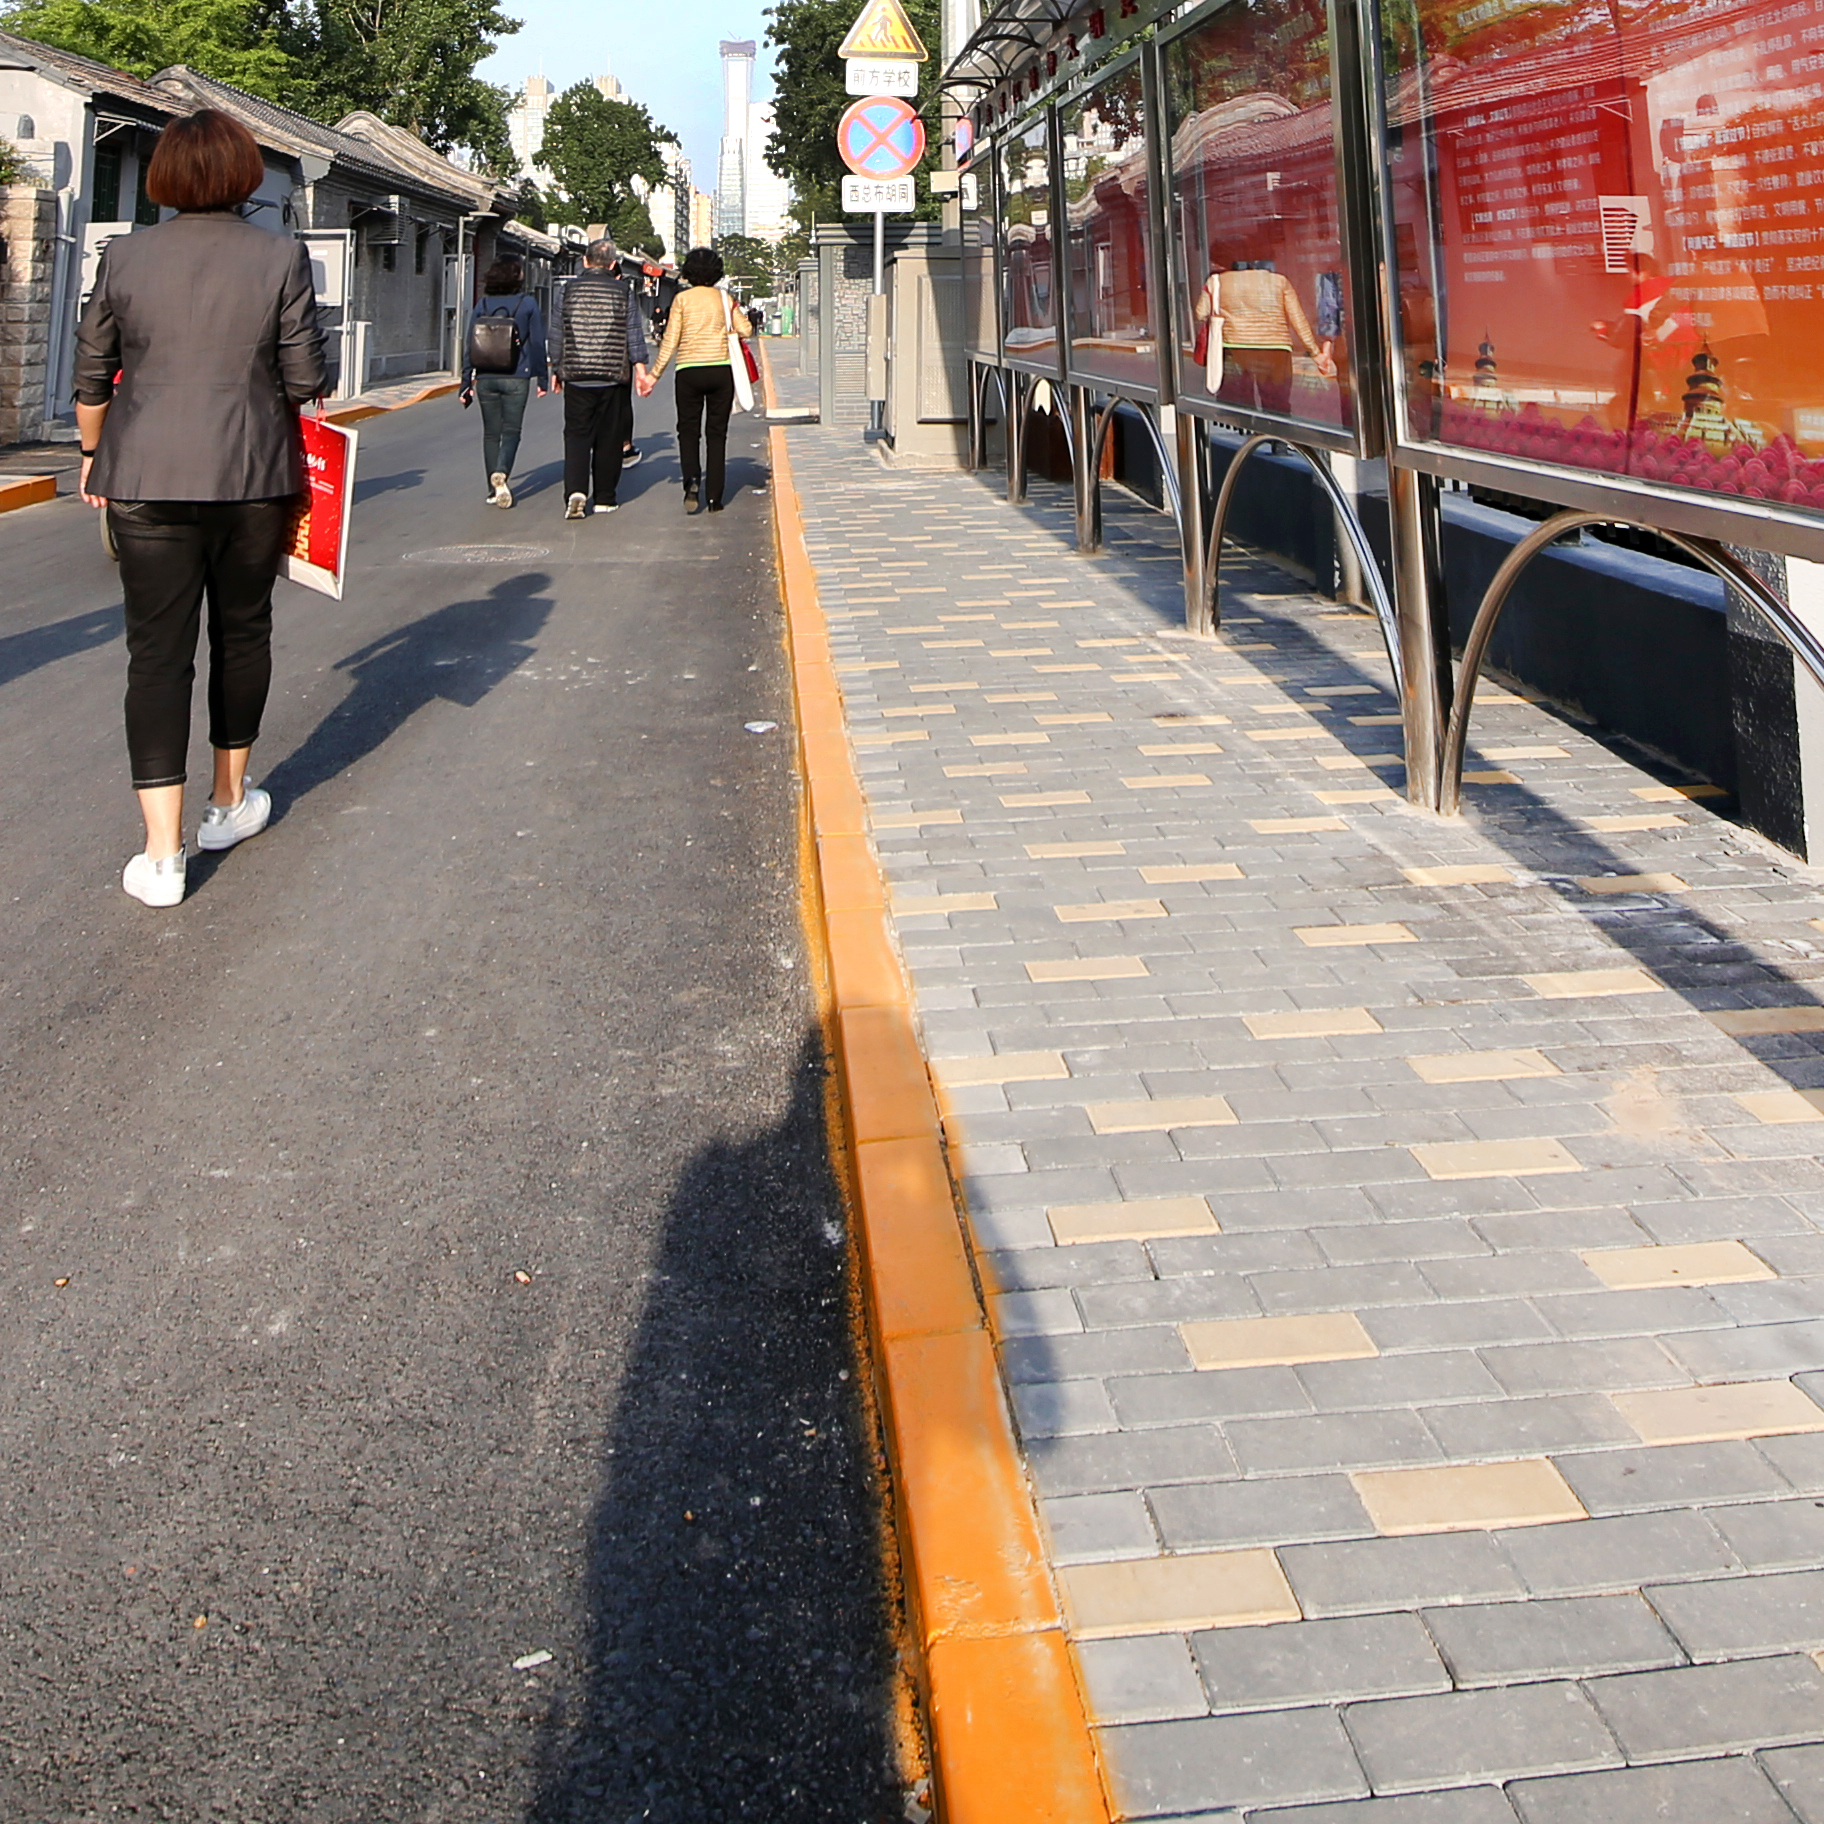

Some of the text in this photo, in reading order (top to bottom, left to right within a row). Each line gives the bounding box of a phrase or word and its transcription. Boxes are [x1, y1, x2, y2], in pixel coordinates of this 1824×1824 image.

[853, 68, 911, 88] 前方学校
[849, 183, 909, 204] 西总布胡同
